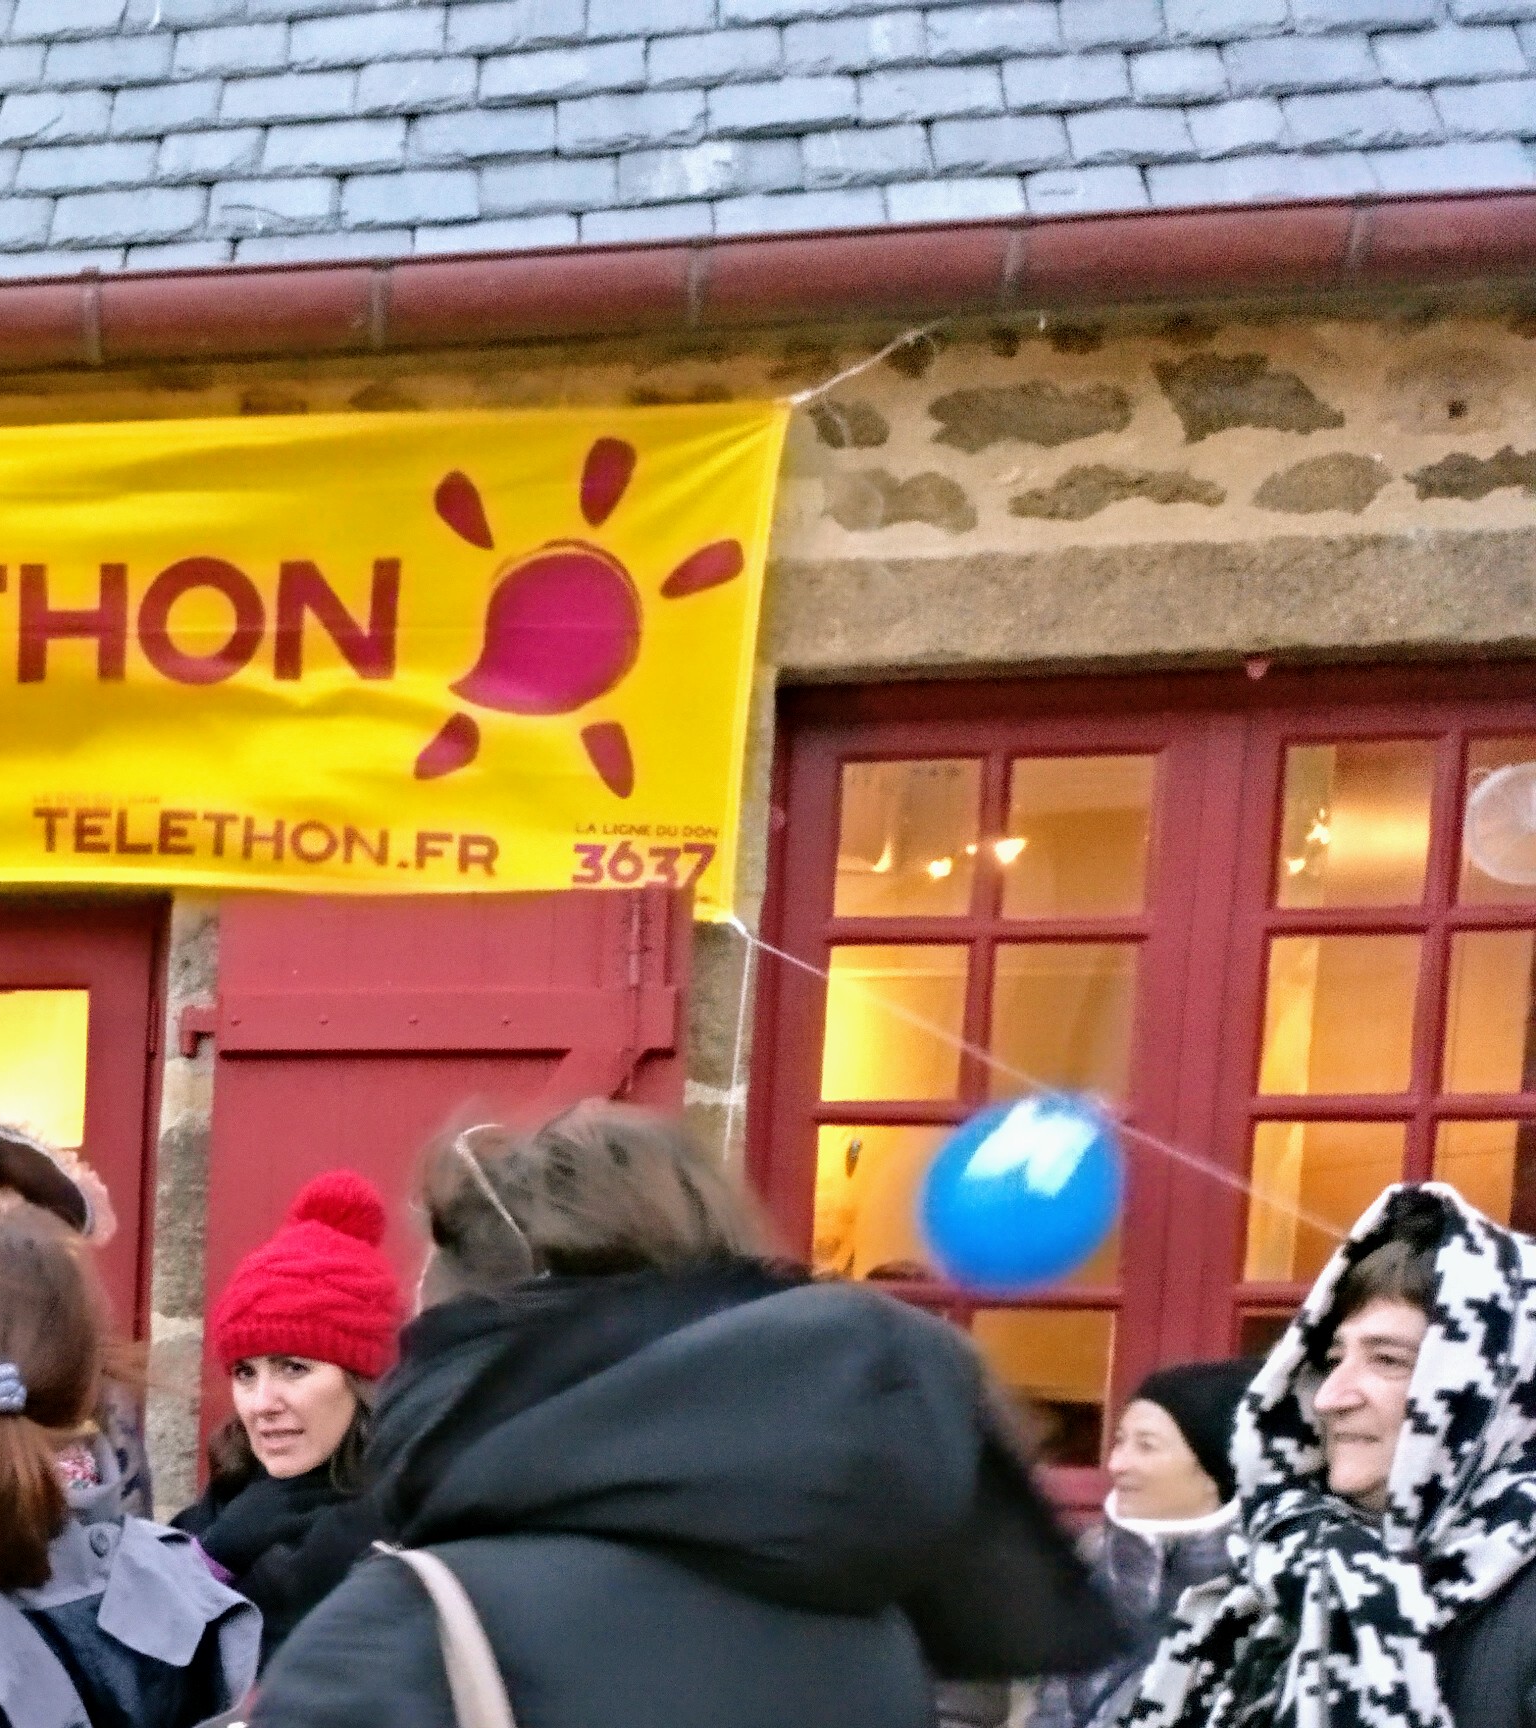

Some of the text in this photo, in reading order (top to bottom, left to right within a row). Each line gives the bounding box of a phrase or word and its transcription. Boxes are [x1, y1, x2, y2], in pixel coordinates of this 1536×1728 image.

[33, 807, 500, 878] TELETHON.FR
[574, 822, 597, 835] LA
[655, 823, 678, 838] DU
[571, 839, 718, 888] 3637
